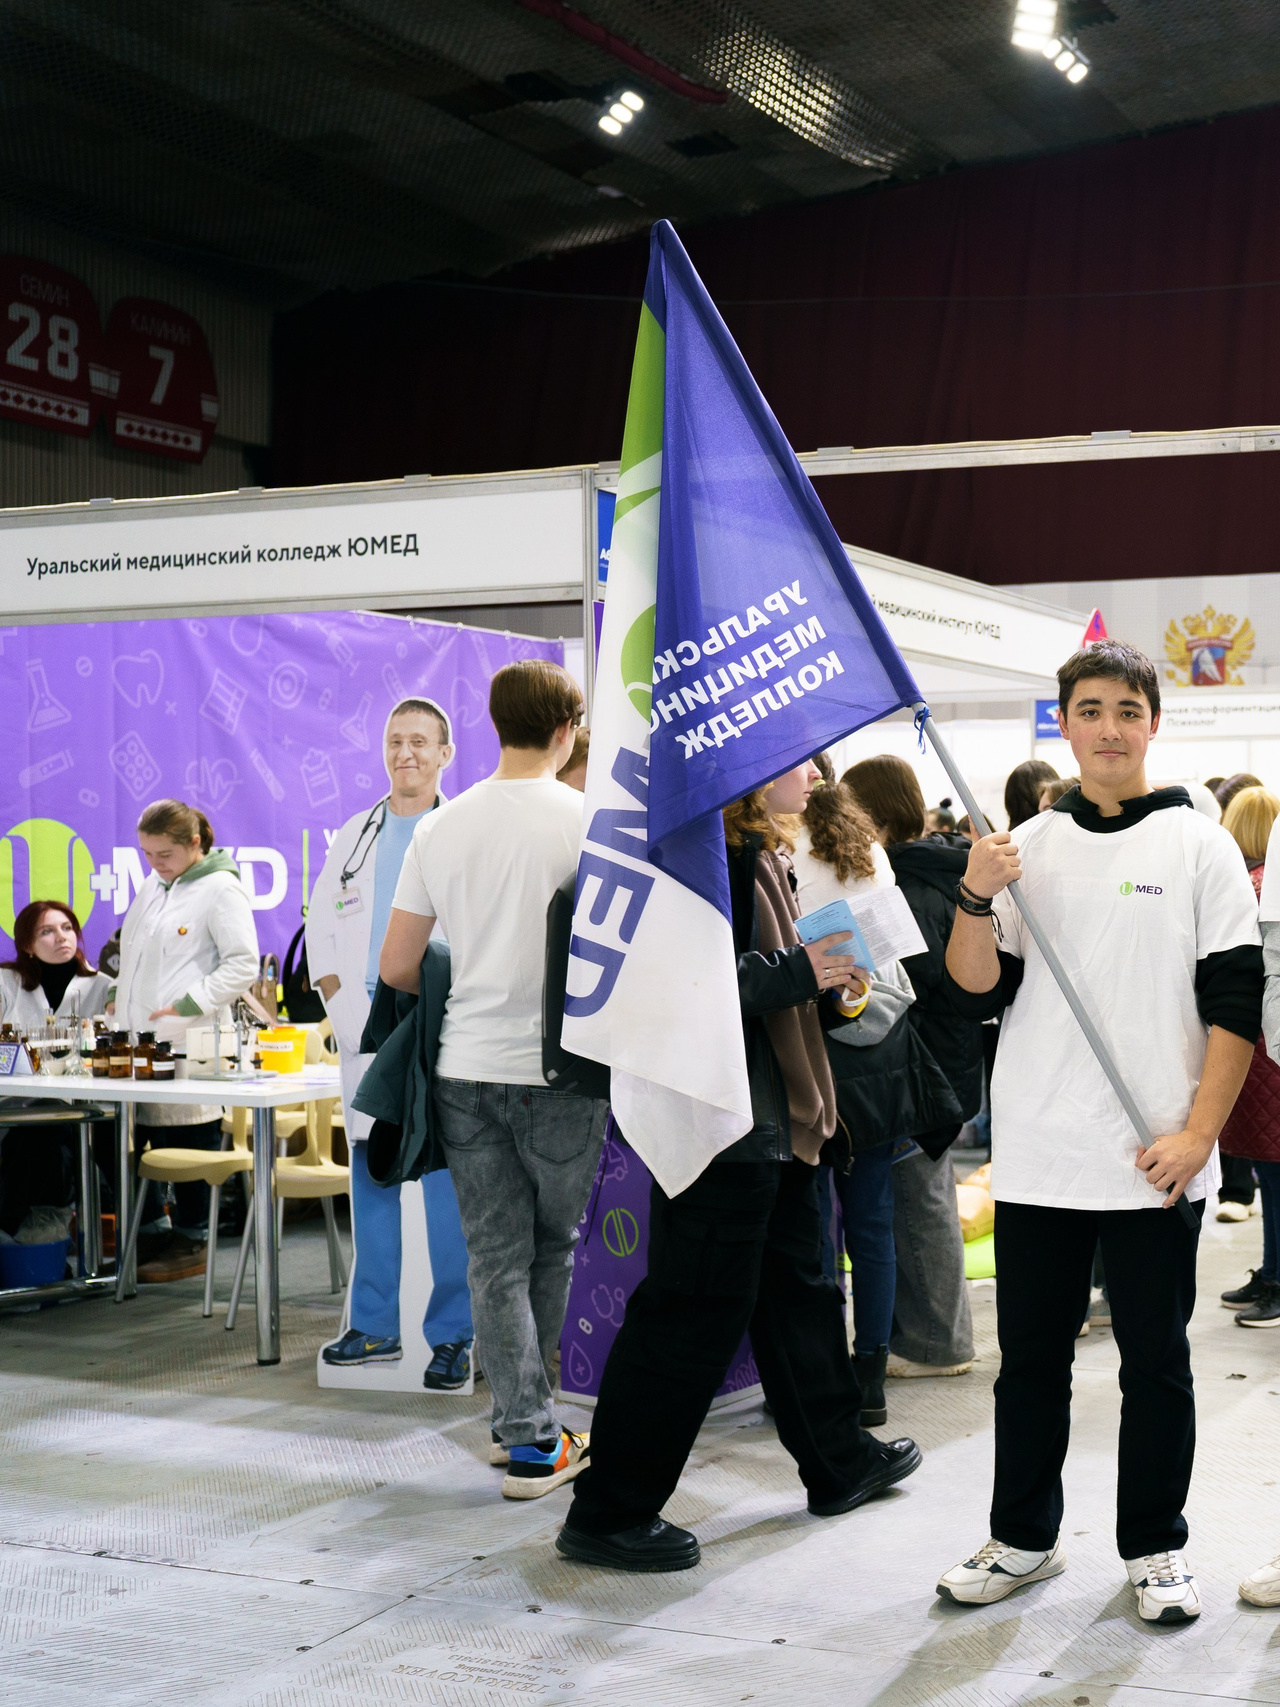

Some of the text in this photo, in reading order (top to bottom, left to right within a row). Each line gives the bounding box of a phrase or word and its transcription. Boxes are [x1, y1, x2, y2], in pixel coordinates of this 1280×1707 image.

[6, 302, 79, 382] 28
[149, 344, 174, 406] 7
[26, 532, 419, 580] Уральский медицинский колледж ЮМЕД
[877, 601, 1001, 640] медицинский институт ЮМЕД
[390, 1663, 551, 1694] TERRACOVER
